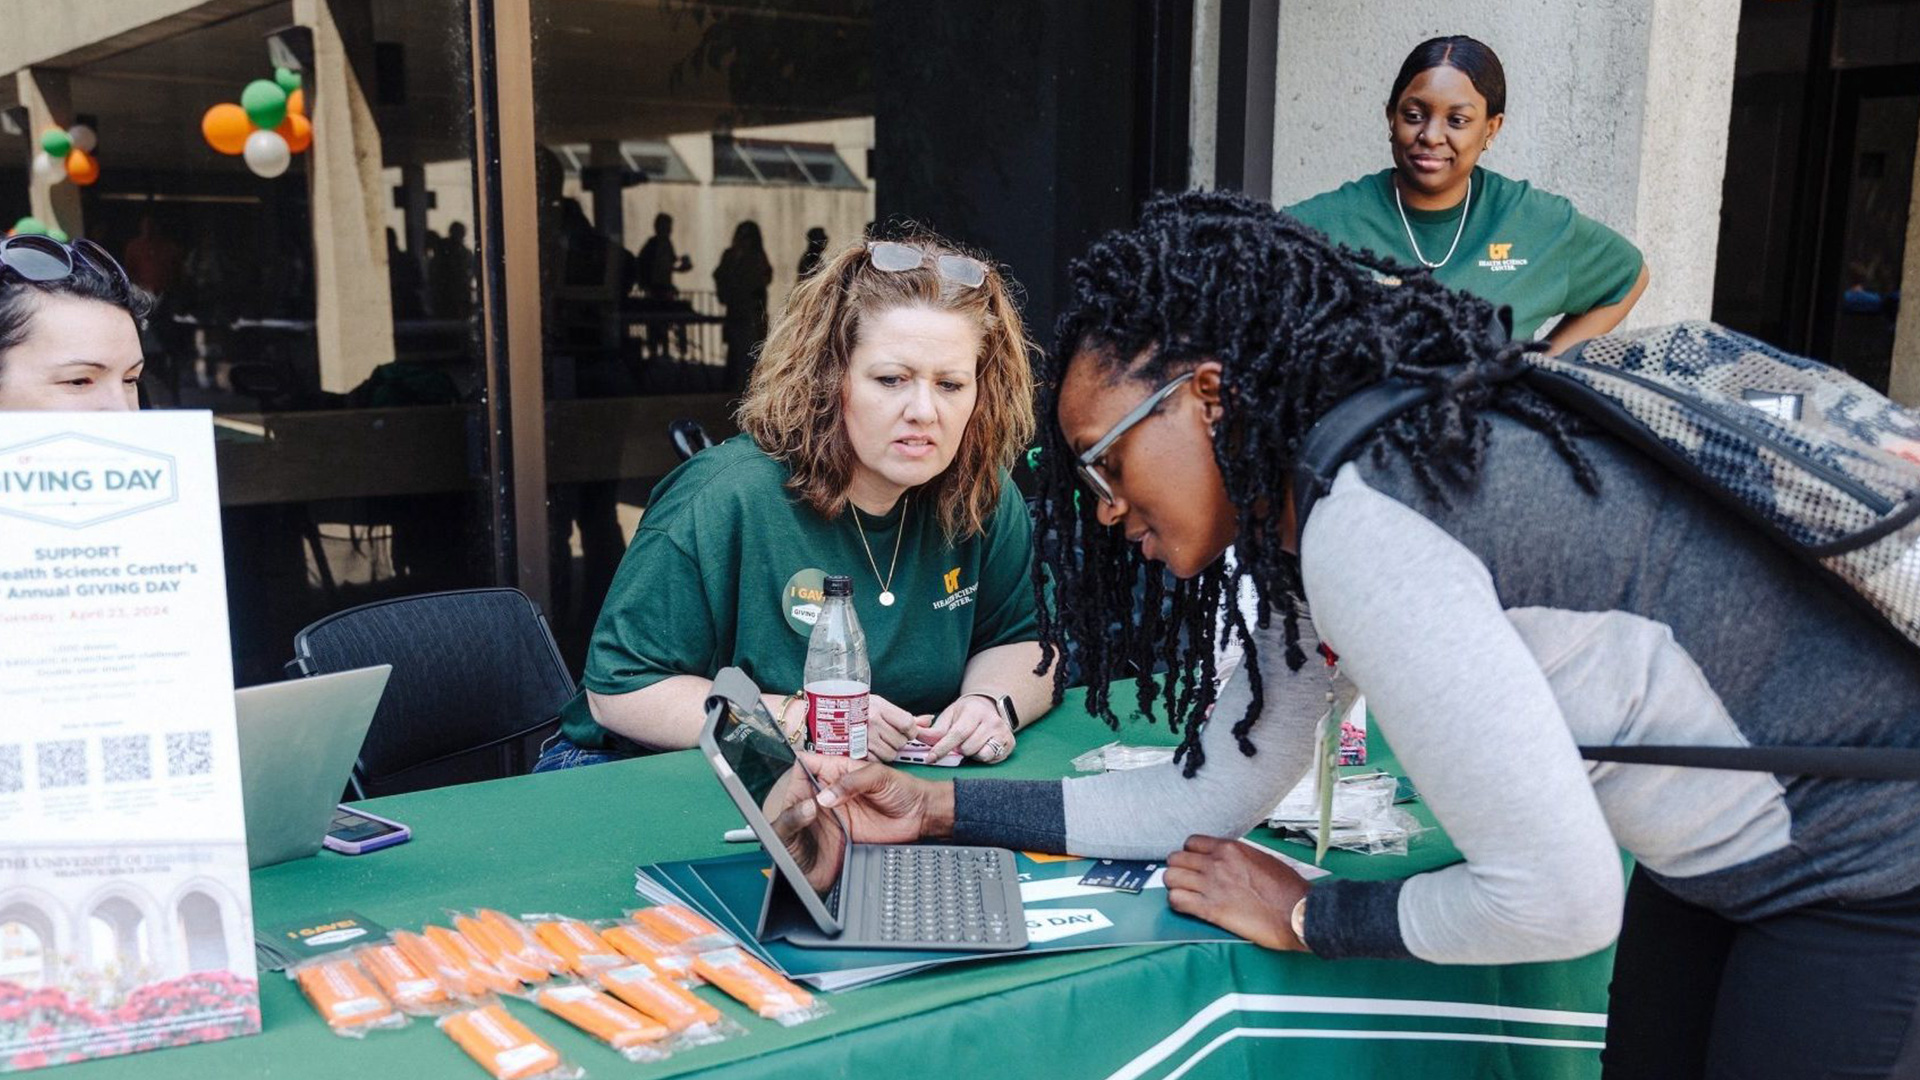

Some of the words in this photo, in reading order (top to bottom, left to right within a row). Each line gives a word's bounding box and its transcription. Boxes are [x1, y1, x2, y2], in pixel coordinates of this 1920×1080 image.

[0, 470, 93, 493] IVING
[105, 469, 162, 491] DAY
[35, 546, 121, 561] SUPPORT
[0, 566, 47, 581] ealth
[53, 565, 121, 579] Science
[126, 562, 198, 577] Center's
[8, 585, 70, 599] Annual
[77, 582, 140, 597] GIVING
[146, 580, 180, 594] DAY
[798, 588, 826, 602] GAV
[1047, 914, 1094, 926] DAY
